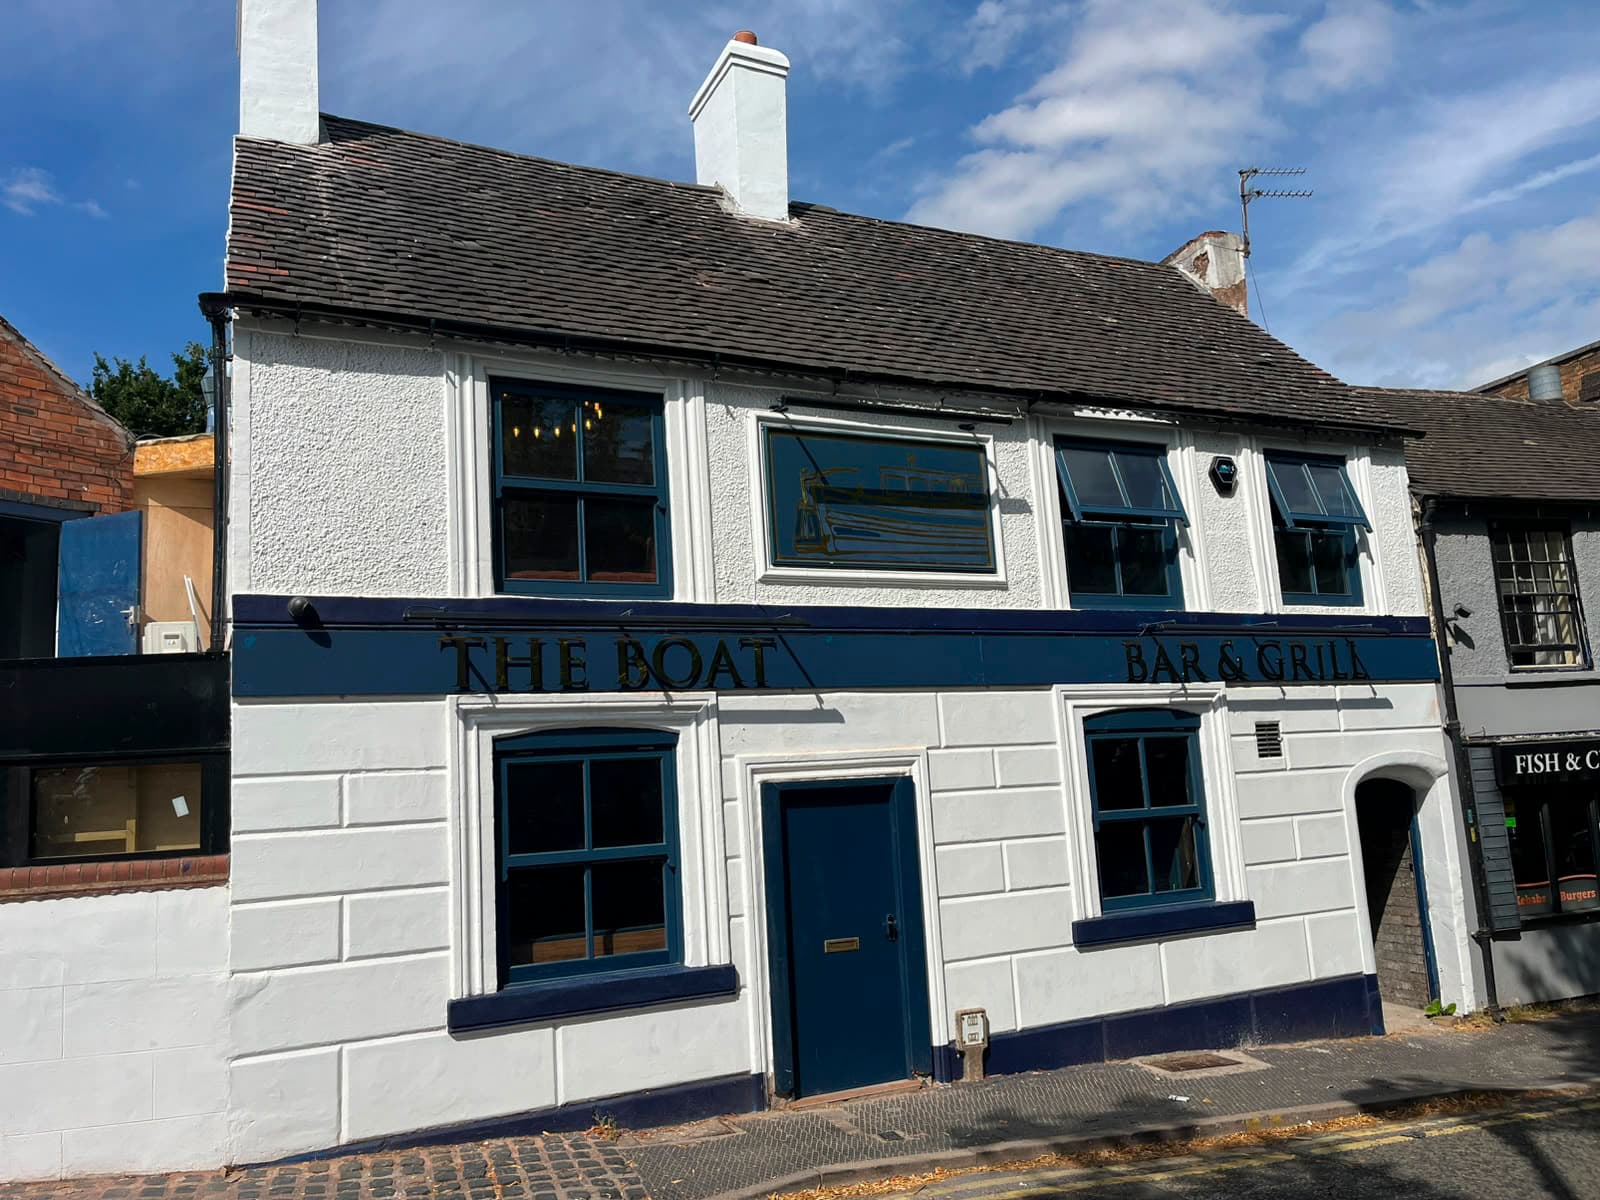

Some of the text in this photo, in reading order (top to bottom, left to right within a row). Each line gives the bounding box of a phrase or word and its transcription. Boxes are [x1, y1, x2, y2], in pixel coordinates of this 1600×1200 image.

[440, 636, 778, 690] THE BOAT
[1121, 640, 1371, 682] BAR & GRILL
[1515, 750, 1600, 774] FISH & C
[1560, 890, 1596, 901] Burgers
